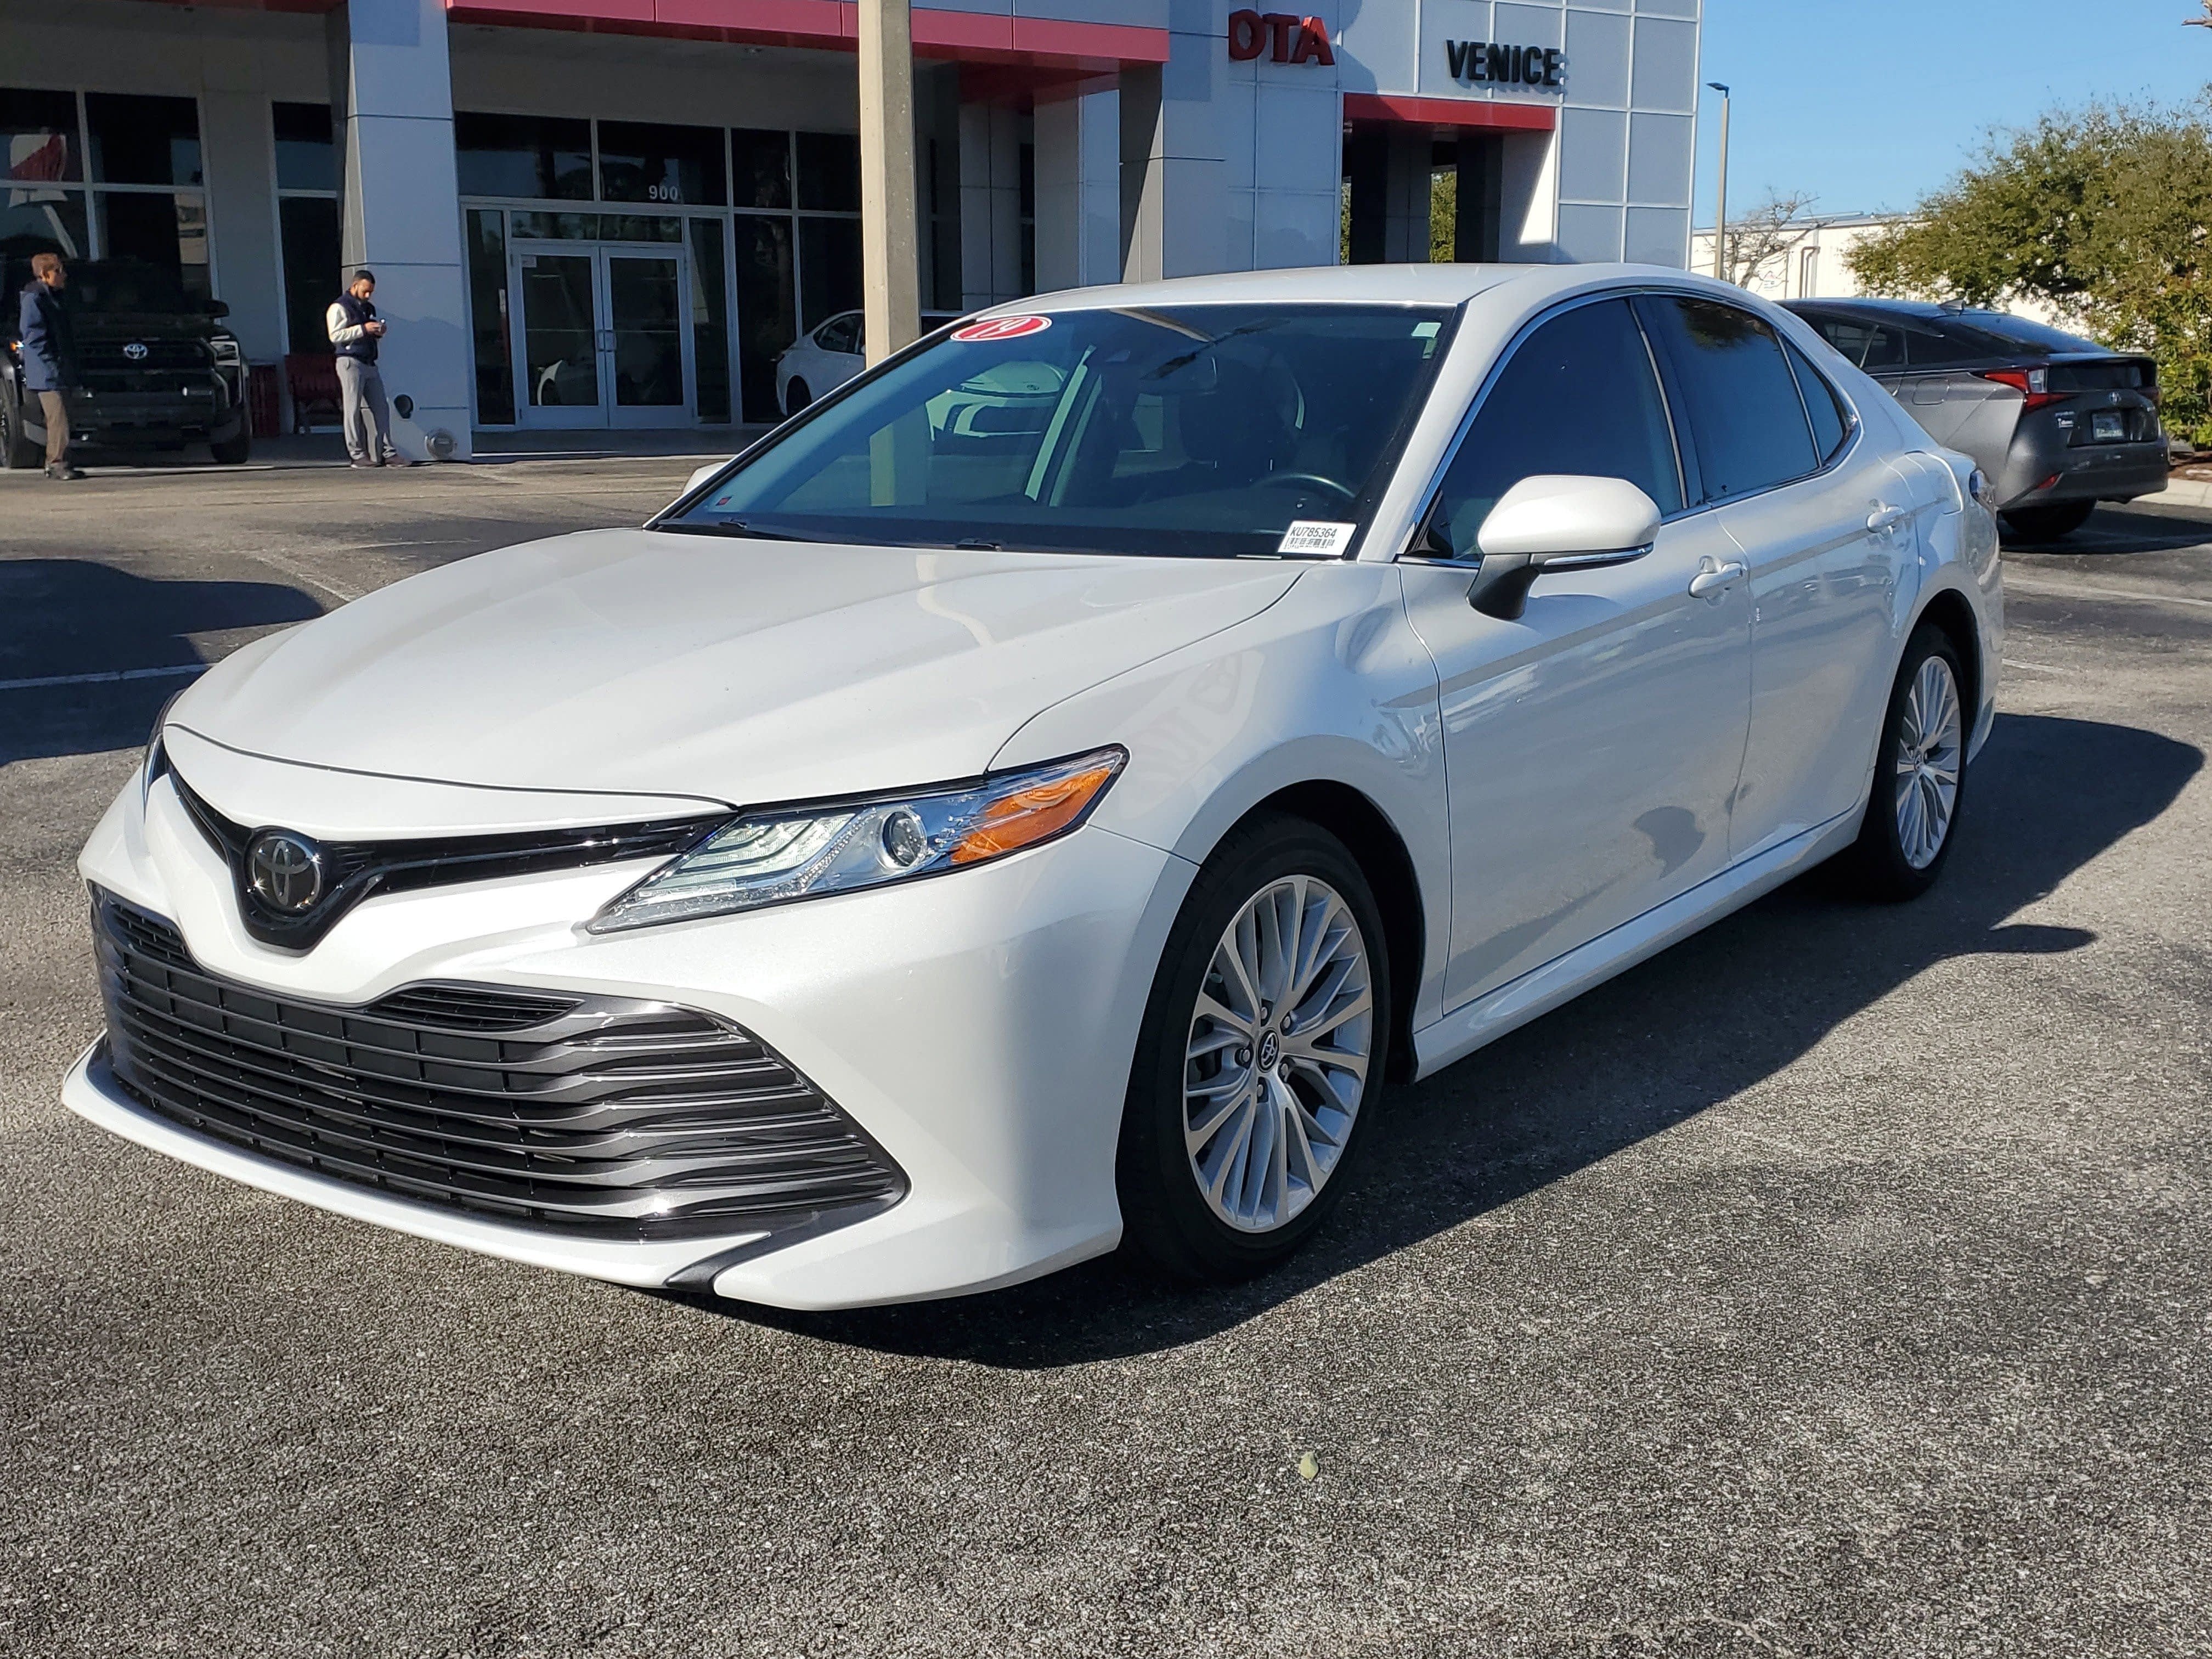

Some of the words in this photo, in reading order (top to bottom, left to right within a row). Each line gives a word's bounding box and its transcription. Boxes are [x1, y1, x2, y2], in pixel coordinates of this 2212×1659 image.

[1446, 40, 1561, 86] VENICE
[648, 185, 678, 200] 900
[1290, 527, 1338, 538] KU785364
